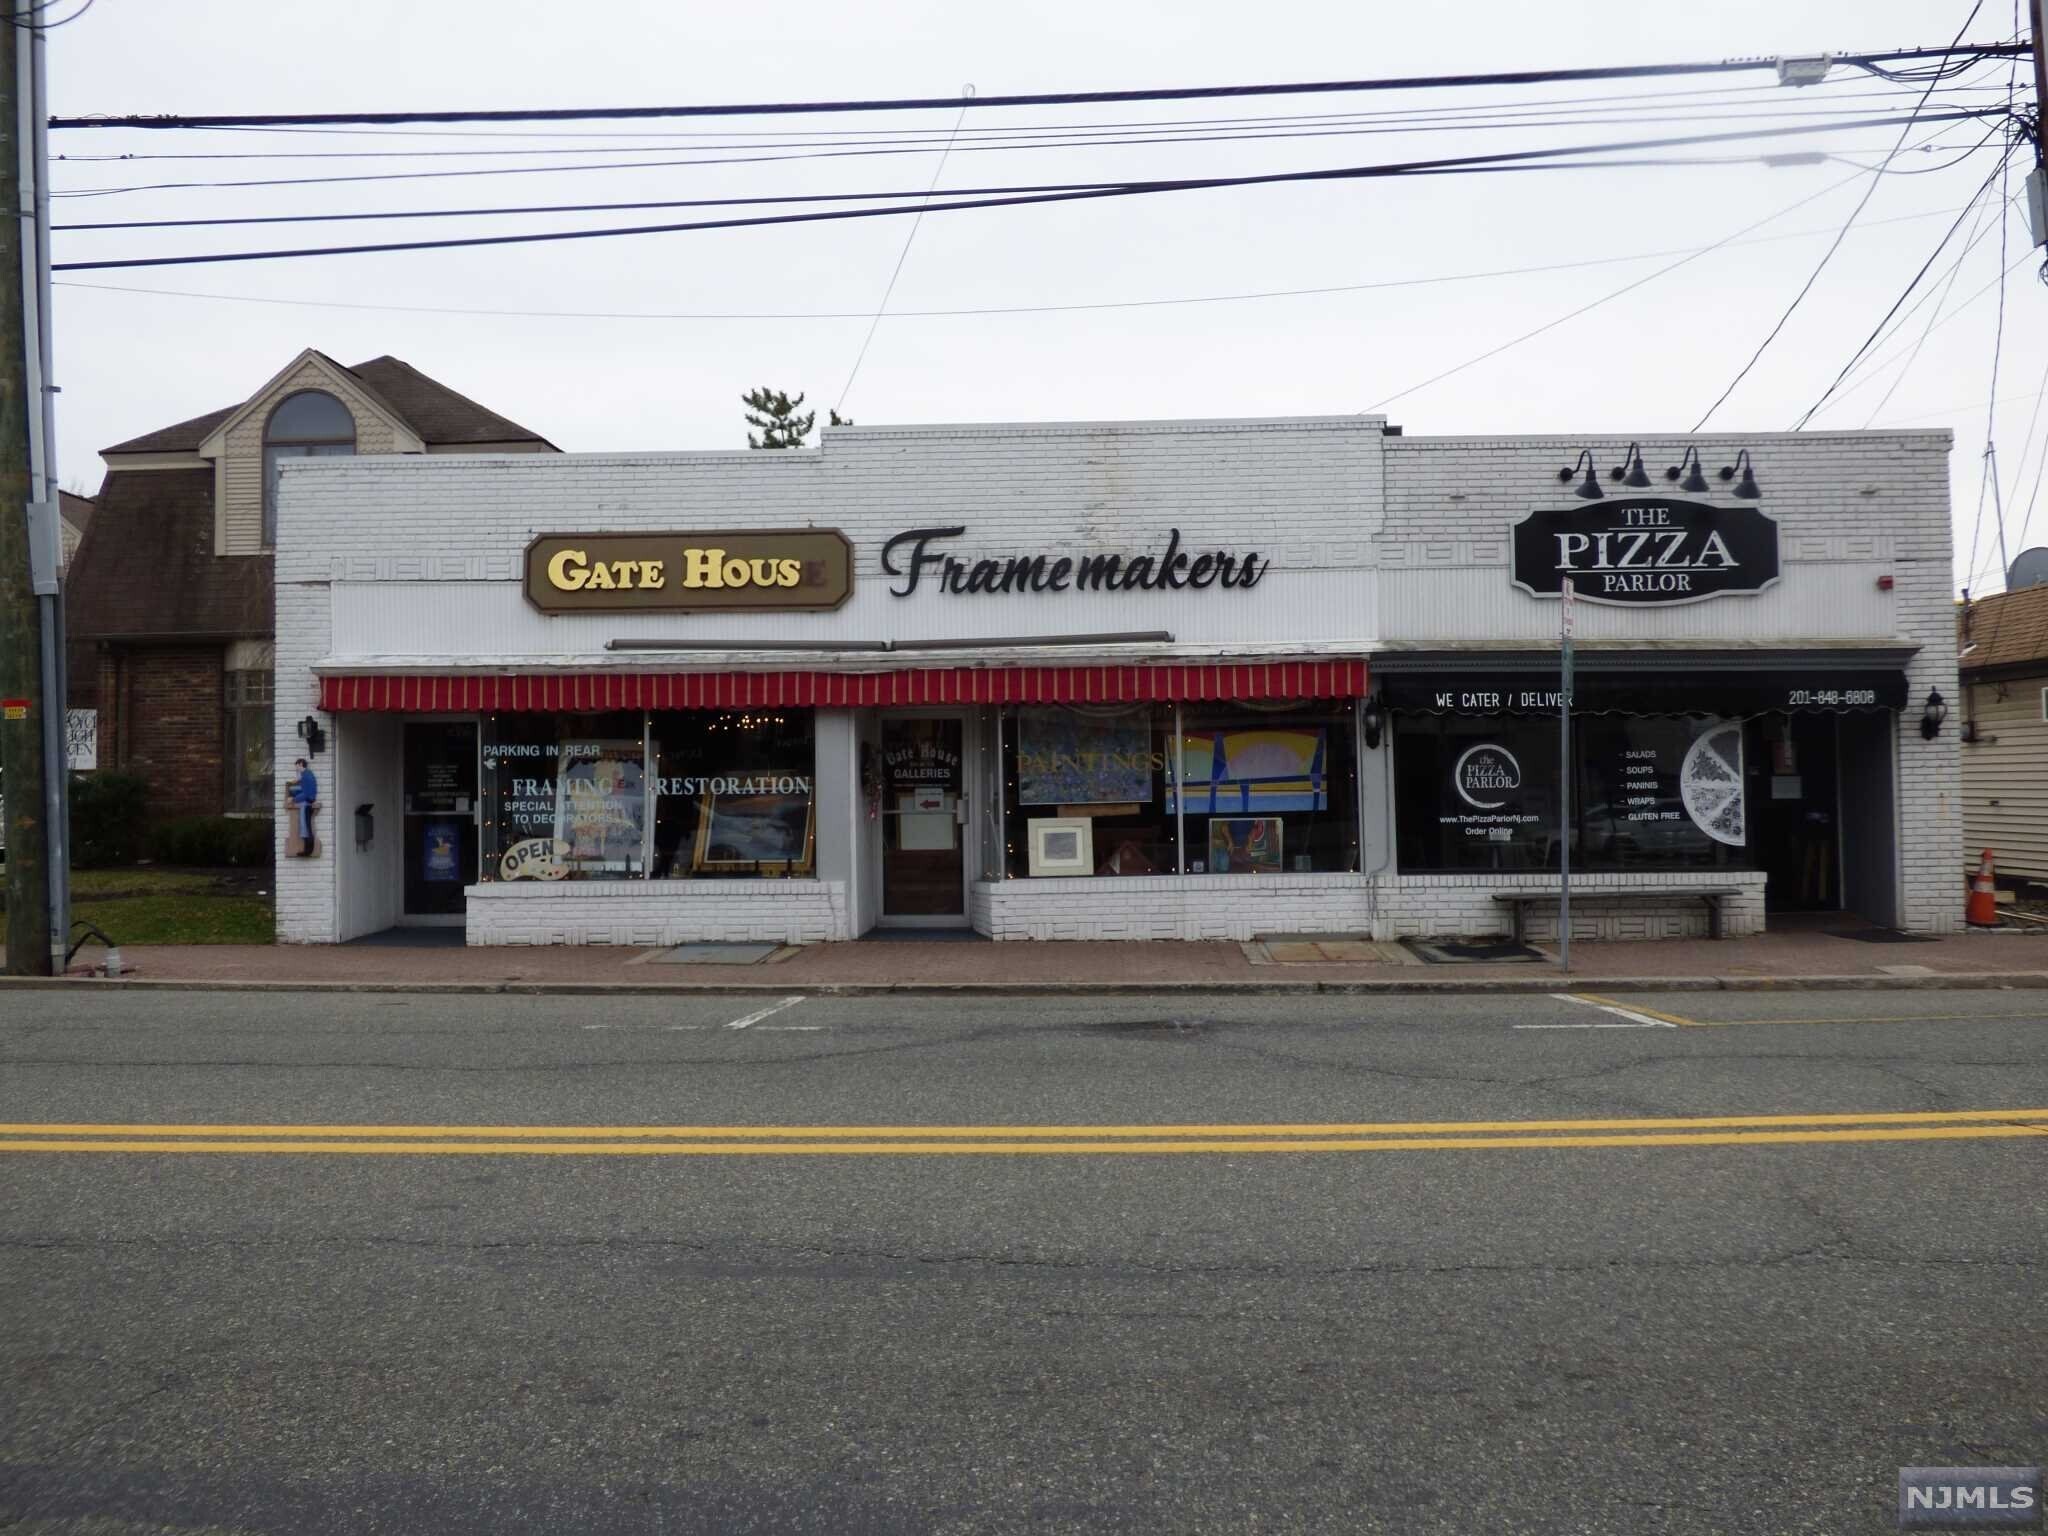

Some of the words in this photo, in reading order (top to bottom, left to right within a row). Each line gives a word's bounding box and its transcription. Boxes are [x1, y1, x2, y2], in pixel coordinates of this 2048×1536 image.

[1621, 508, 1671, 526] THE
[1553, 530, 1741, 569] PIZZA
[881, 525, 1270, 598] Framemakers
[1603, 574, 1692, 592] PARLOR
[1436, 693, 1454, 707] WE
[1462, 693, 1500, 707] CATER
[483, 745, 540, 756] PARKING
[546, 745, 559, 756] IN
[565, 745, 600, 756] REAR
[1016, 751, 1164, 775] PAINTINGS
[1467, 765, 1505, 776] PIZZA
[656, 776, 810, 795] RESTORATION
[1466, 776, 1512, 788] PARLOR
[504, 802, 554, 811] SPECIAL
[513, 815, 529, 824] TO
[1628, 813, 1659, 821] GLUTEN
[1661, 812, 1680, 820] FREE
[1465, 828, 1487, 836] Order
[505, 841, 555, 870] OPEN
